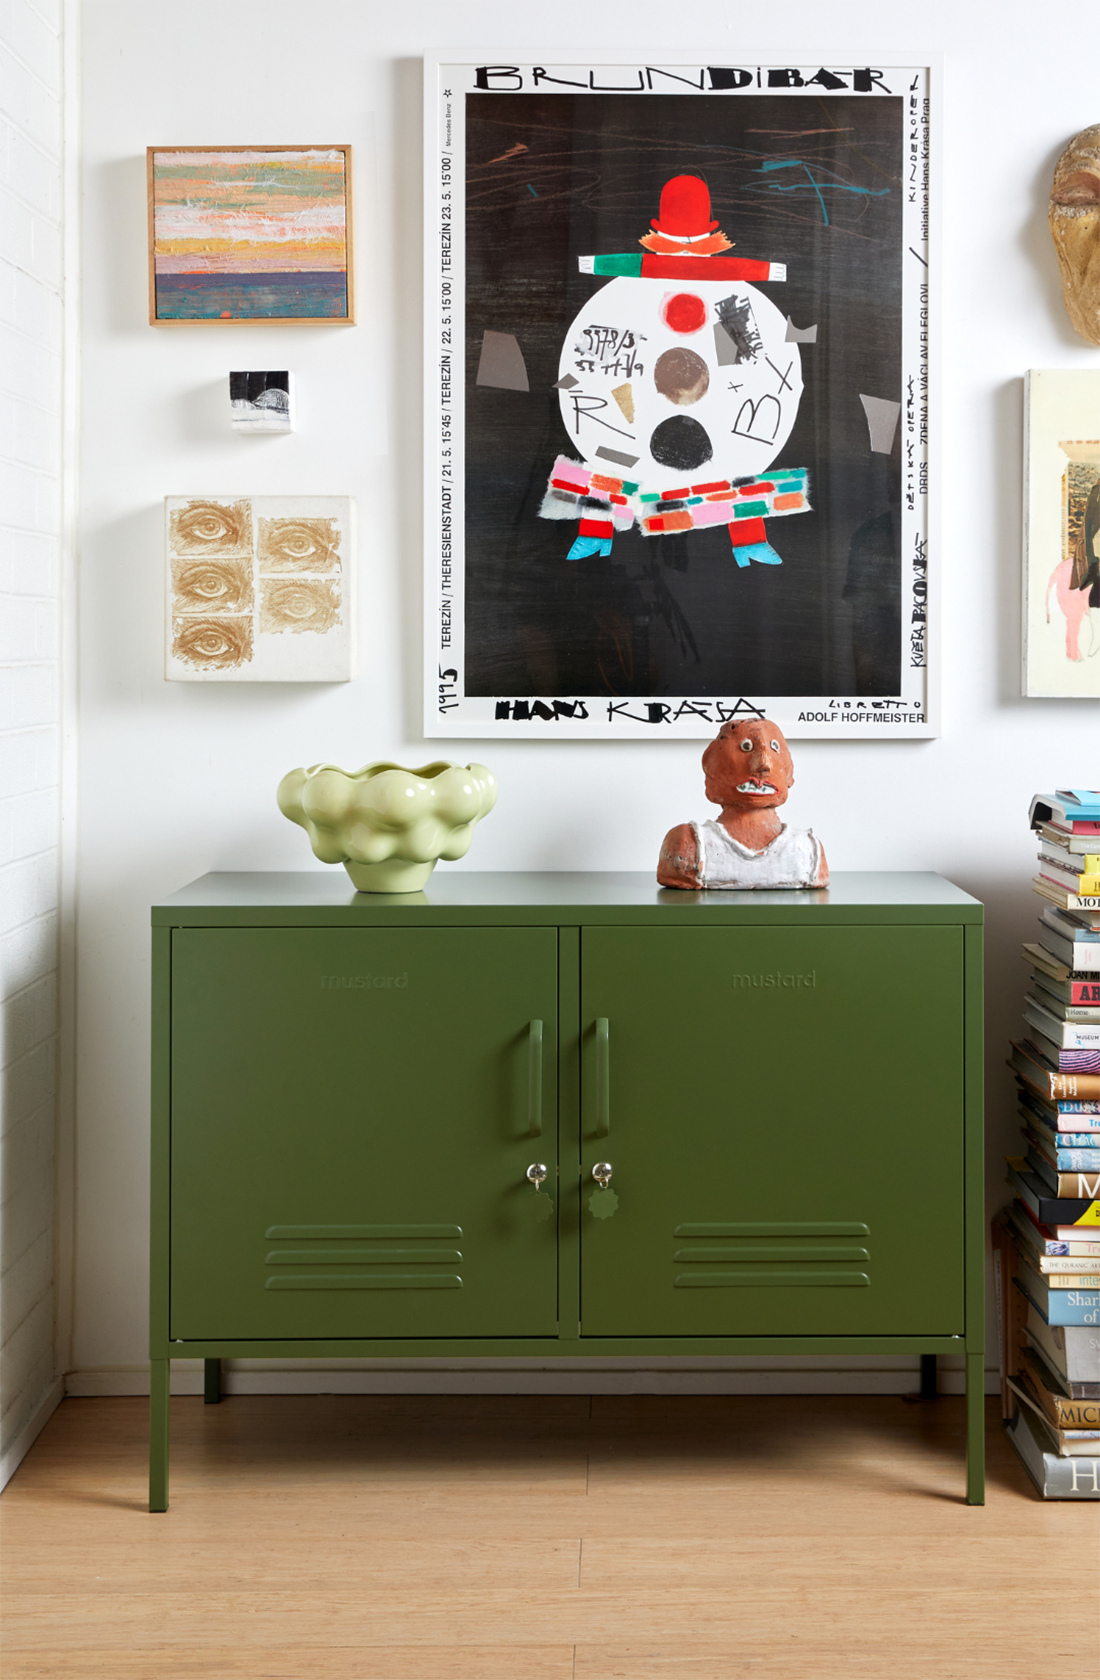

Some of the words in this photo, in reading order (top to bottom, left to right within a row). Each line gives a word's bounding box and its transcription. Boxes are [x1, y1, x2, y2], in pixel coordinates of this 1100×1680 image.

[439, 222, 452, 274] TEREZÍN
[439, 355, 452, 406] TEREZÍN
[441, 485, 452, 591] THERESIENSTADT
[439, 599, 452, 650] TEREZÍN
[438, 664, 459, 714] 1995
[494, 699, 590, 720] HANS
[828, 699, 922, 709] LIBRETTO
[797, 711, 838, 722] ADOLF
[841, 712, 926, 723] HOFFMEISTER
[321, 971, 408, 990] mustard
[732, 969, 816, 989] mustard
[1066, 970, 1088, 980] JOAN
[1079, 1275, 1100, 1287] inte
[1083, 1308, 1099, 1324] of
[1060, 1407, 1100, 1423] MIC
